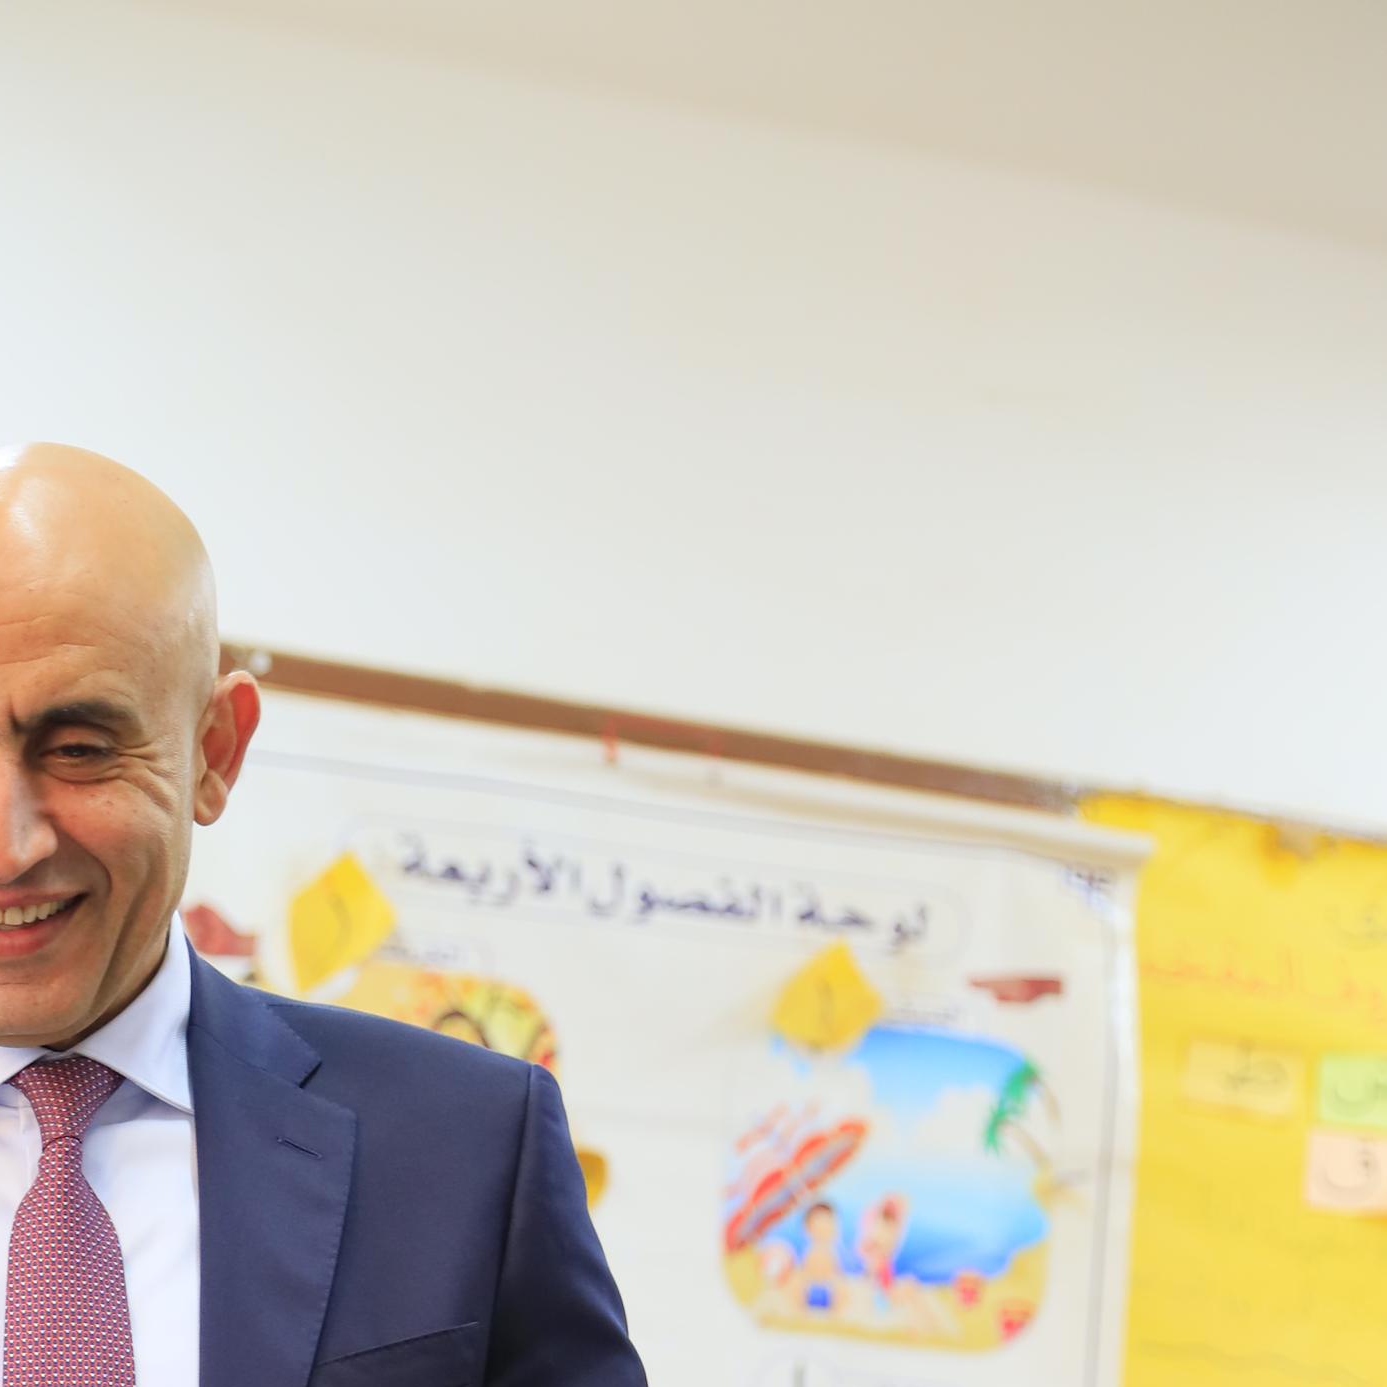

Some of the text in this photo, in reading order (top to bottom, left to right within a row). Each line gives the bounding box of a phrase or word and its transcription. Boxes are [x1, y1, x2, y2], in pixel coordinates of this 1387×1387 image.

[398, 832, 931, 958] لوحة الفصول الأربعة
